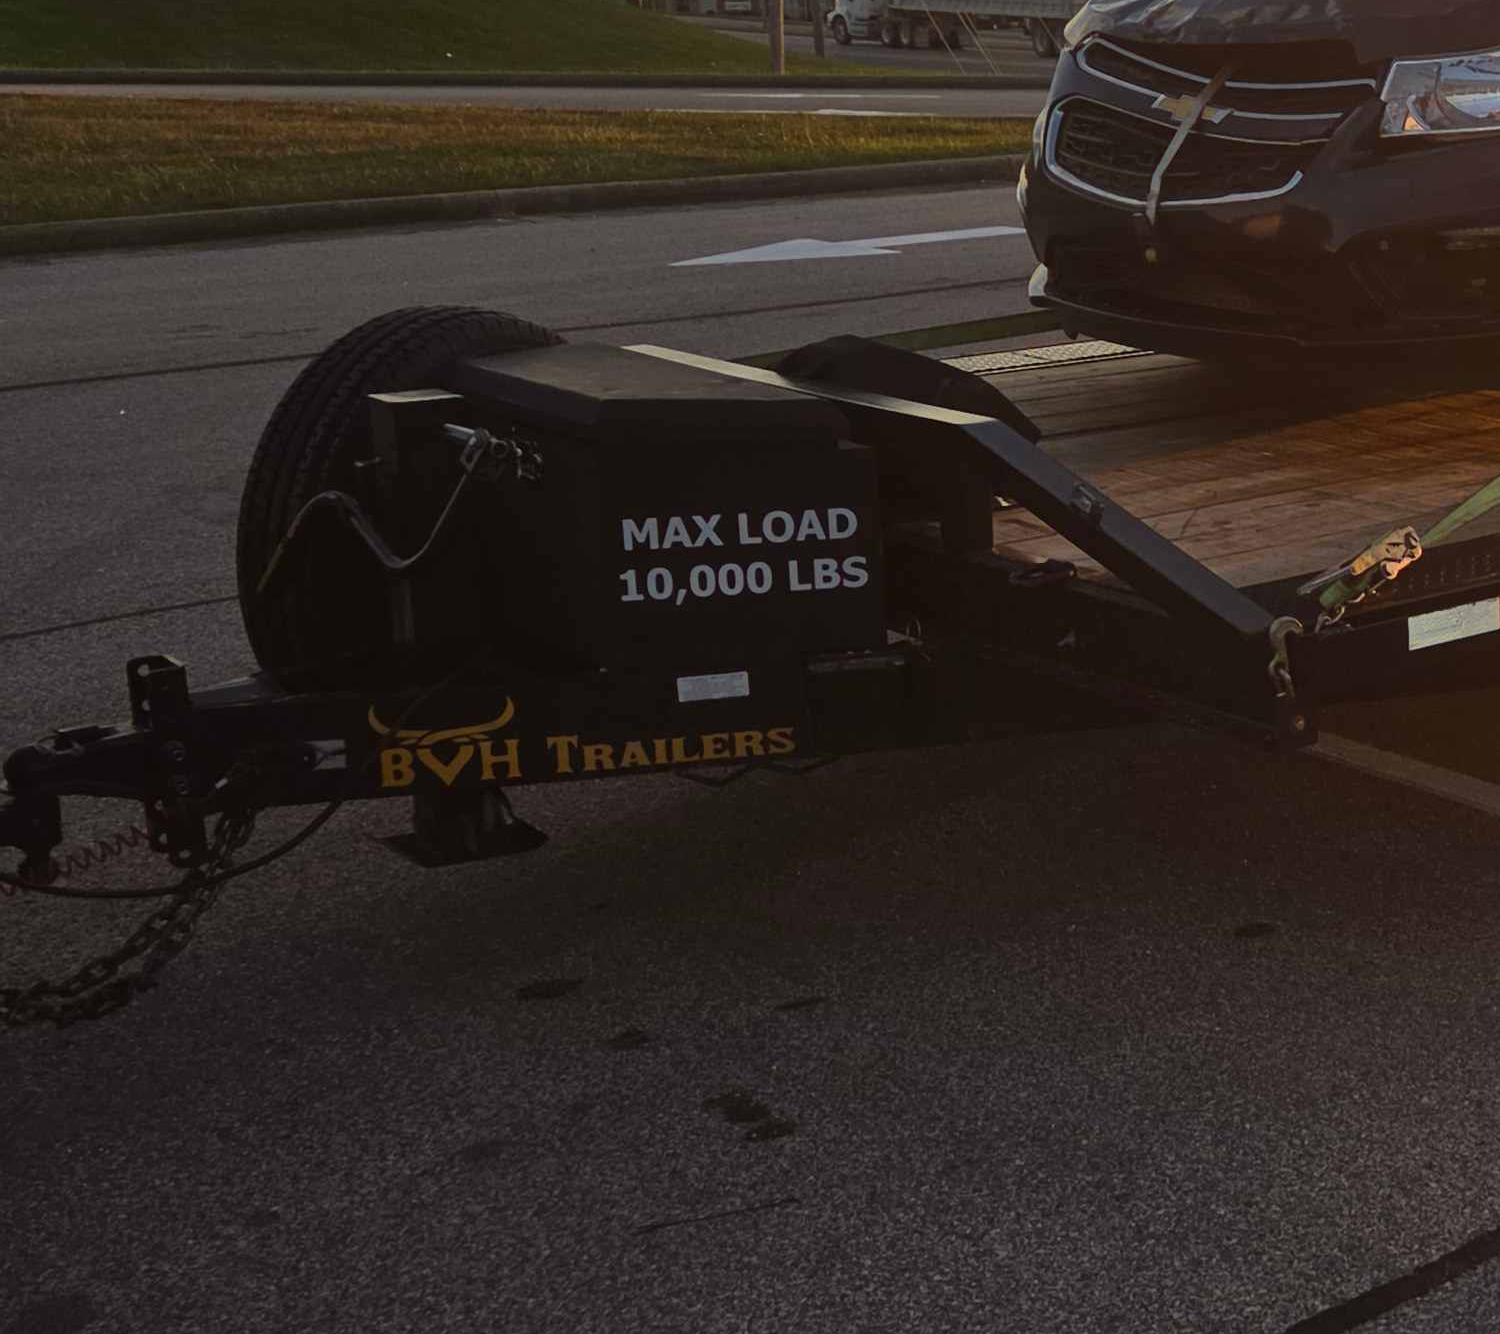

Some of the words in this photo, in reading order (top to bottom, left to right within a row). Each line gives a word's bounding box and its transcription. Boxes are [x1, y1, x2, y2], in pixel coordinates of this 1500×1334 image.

[621, 513, 724, 552] MAX
[737, 506, 860, 546] LOAD
[618, 560, 774, 608] 10,000
[788, 555, 870, 594] LBS
